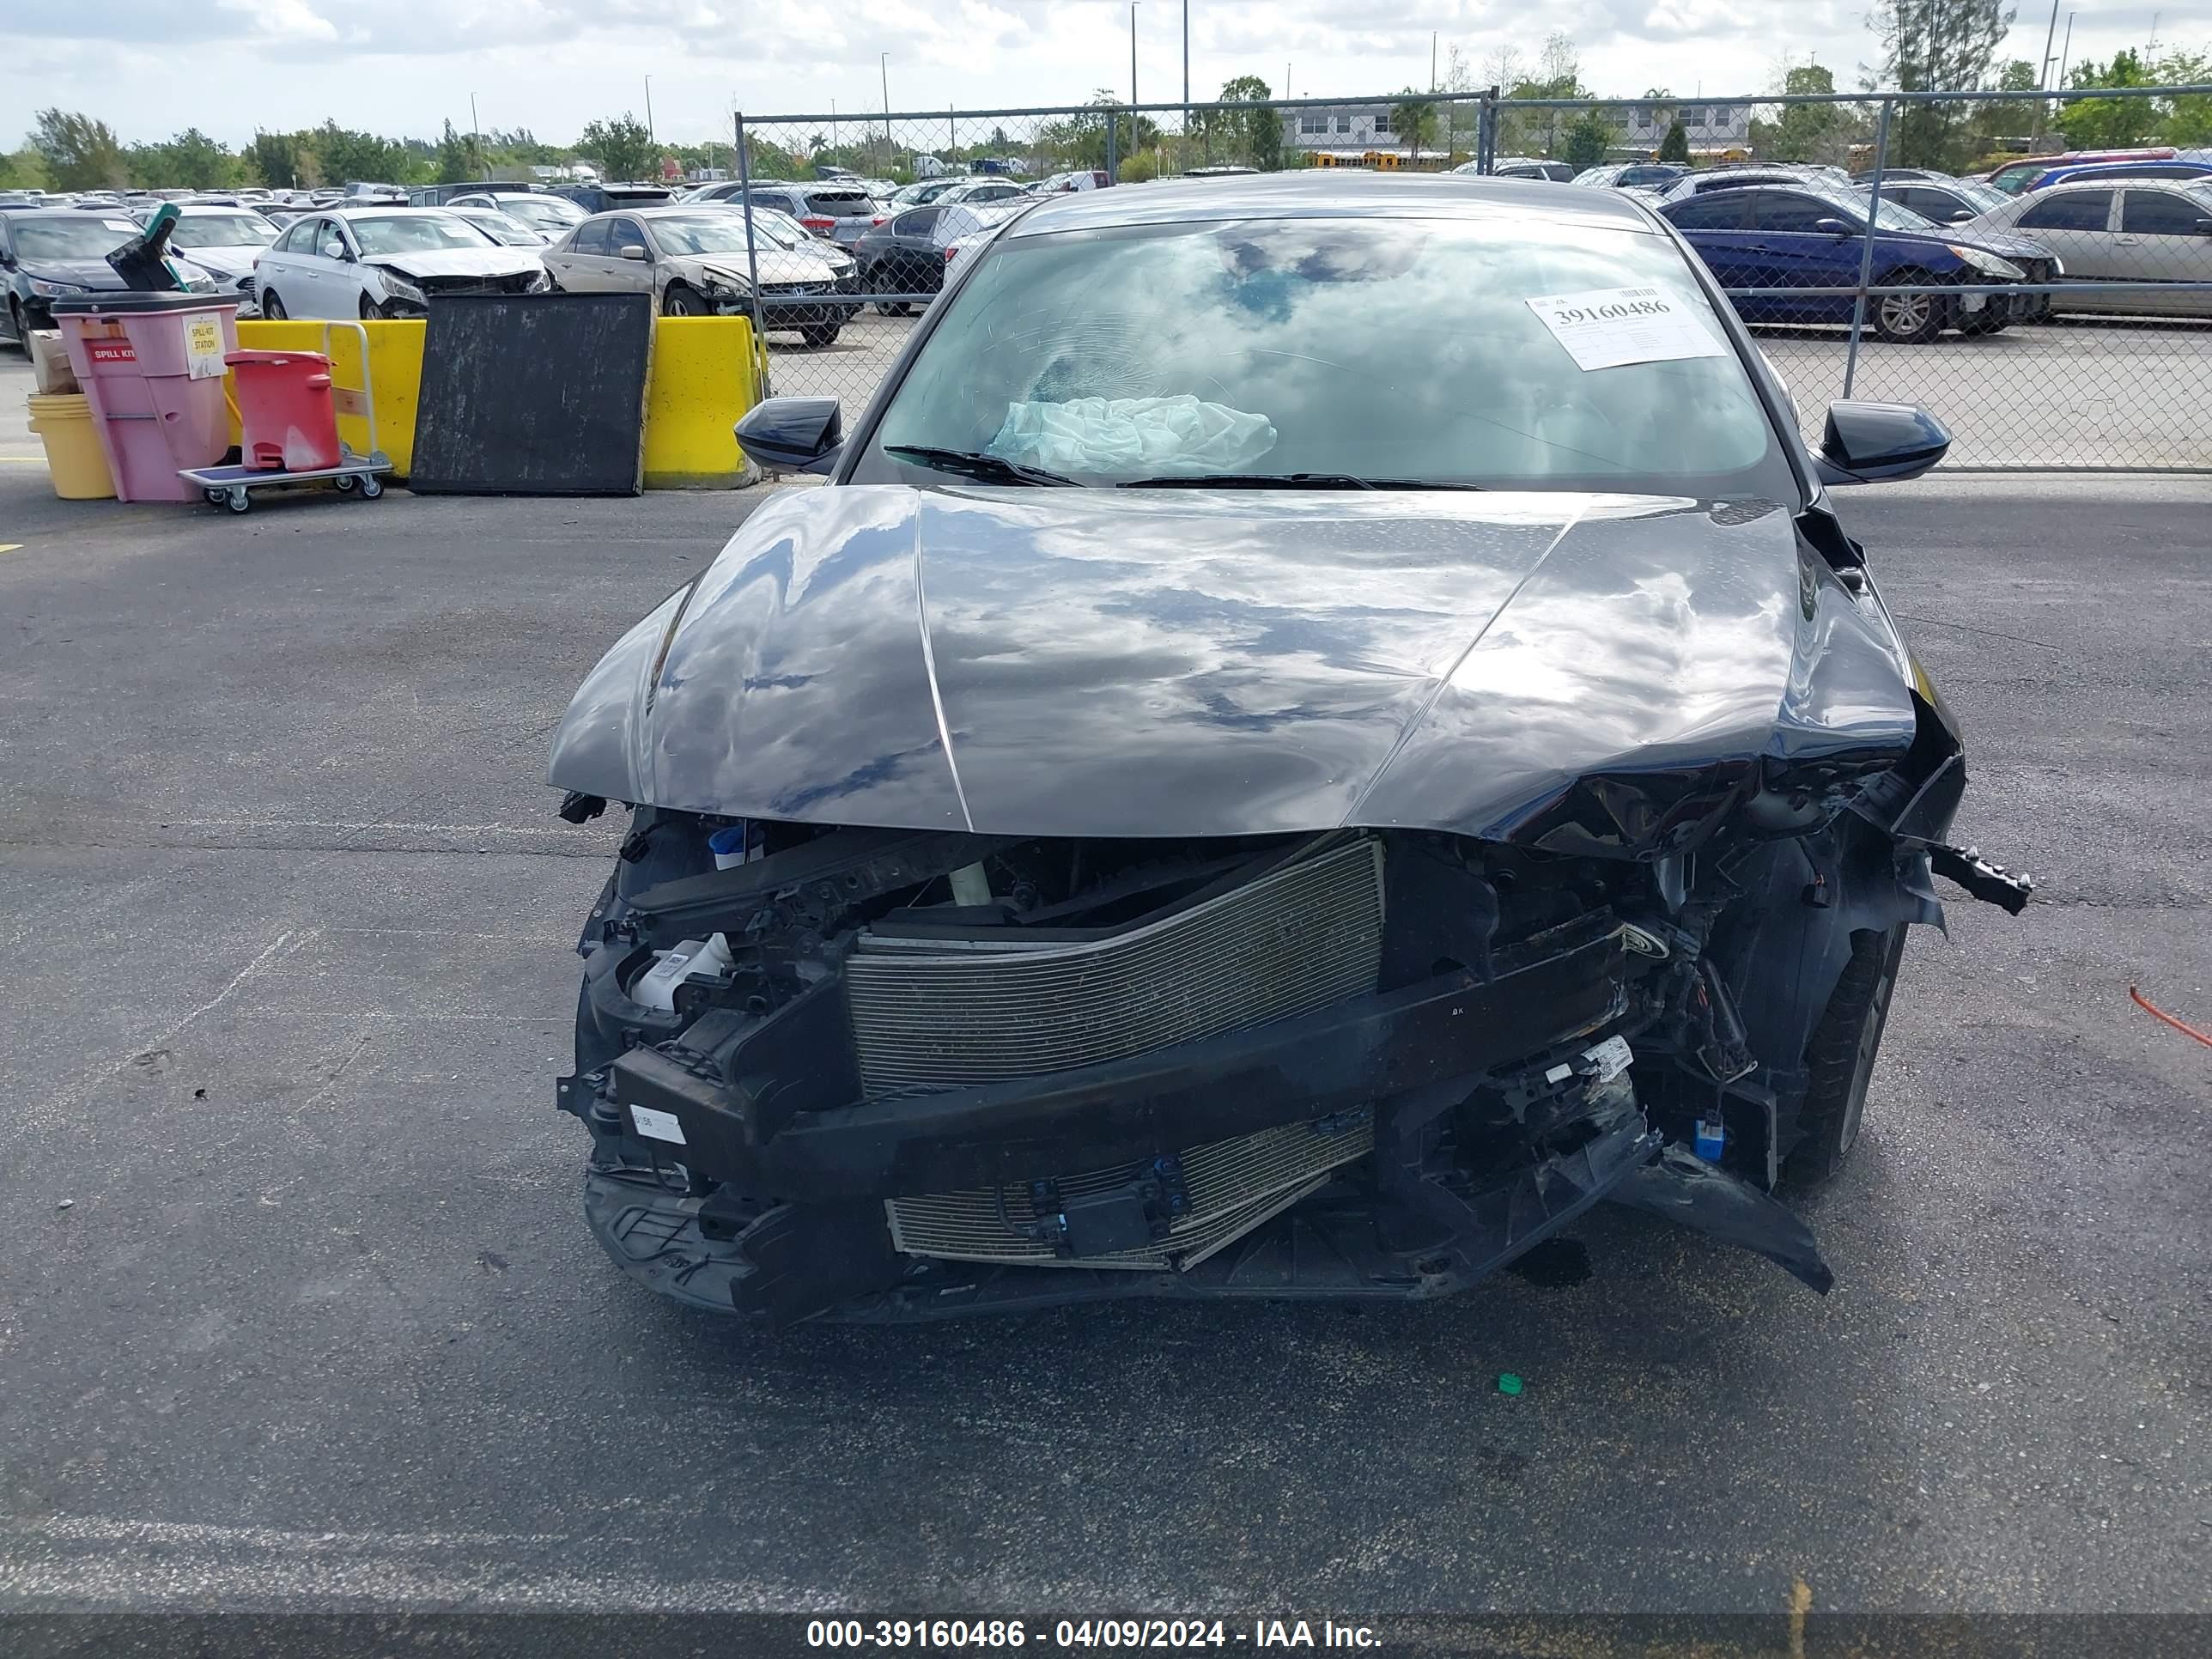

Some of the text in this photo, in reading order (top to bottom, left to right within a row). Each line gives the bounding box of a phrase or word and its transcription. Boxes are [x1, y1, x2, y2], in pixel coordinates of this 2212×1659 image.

[1553, 299, 1671, 325] 39160486
[194, 340, 215, 349] STATION
[94, 350, 120, 359] SPILL
